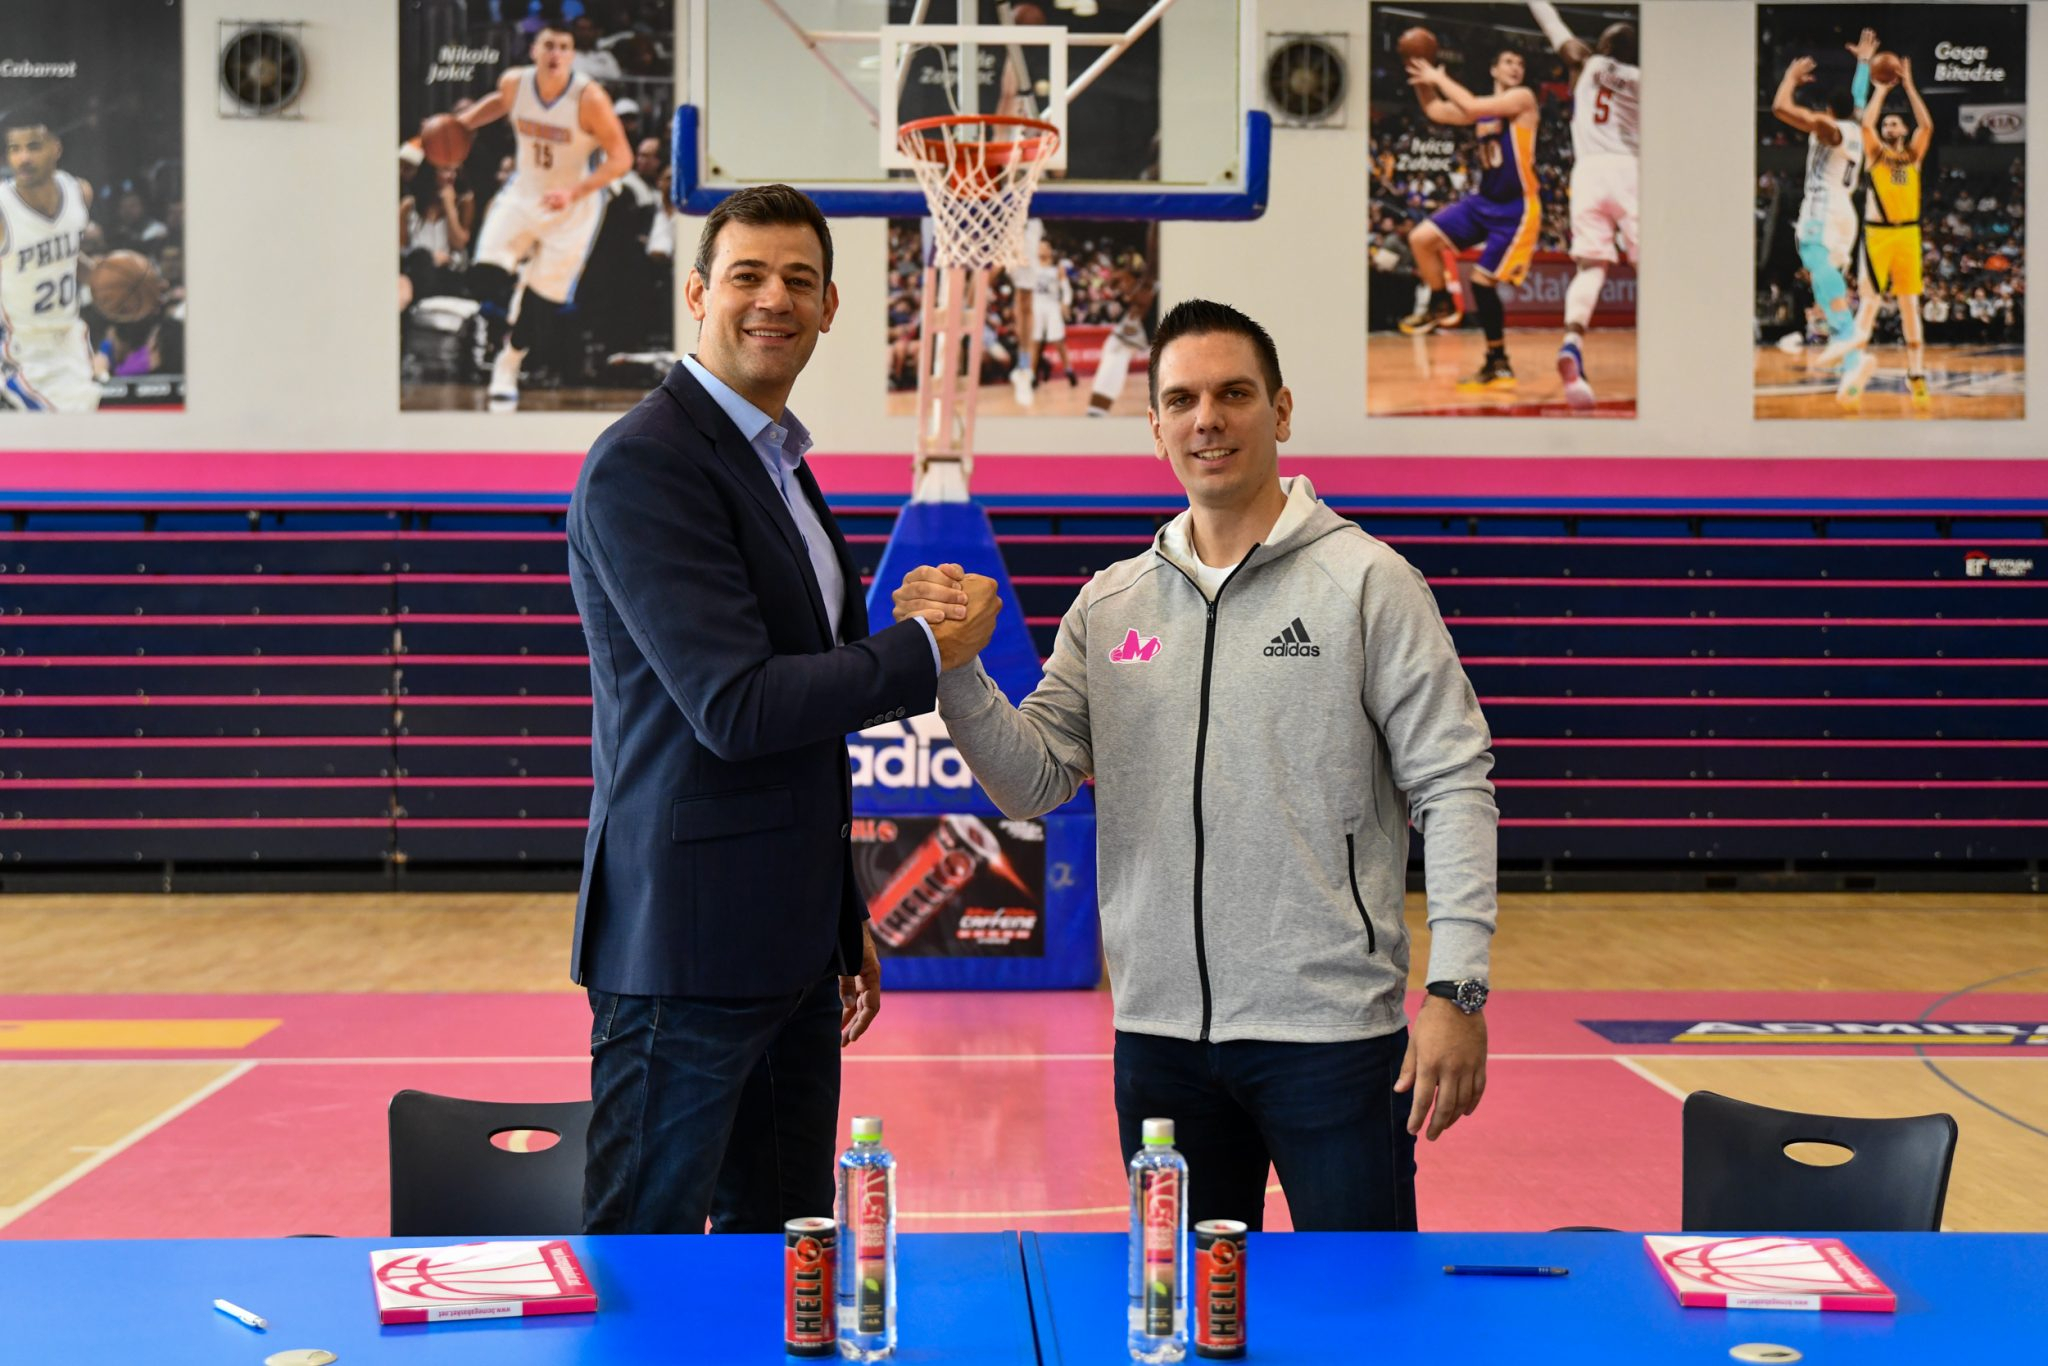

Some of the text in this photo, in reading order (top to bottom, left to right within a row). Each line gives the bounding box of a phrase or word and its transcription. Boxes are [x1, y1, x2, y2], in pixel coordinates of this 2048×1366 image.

[438, 45, 500, 64] Nikola
[1934, 41, 1989, 64] Goga
[1934, 62, 2007, 82] Bitadze
[34, 274, 75, 313] 20
[1519, 271, 1569, 302] Stat
[1263, 643, 1320, 657] adidas
[1685, 1021, 2048, 1036] ADMIR
[795, 1267, 824, 1336] HELL
[1210, 1271, 1238, 1339] HELL
